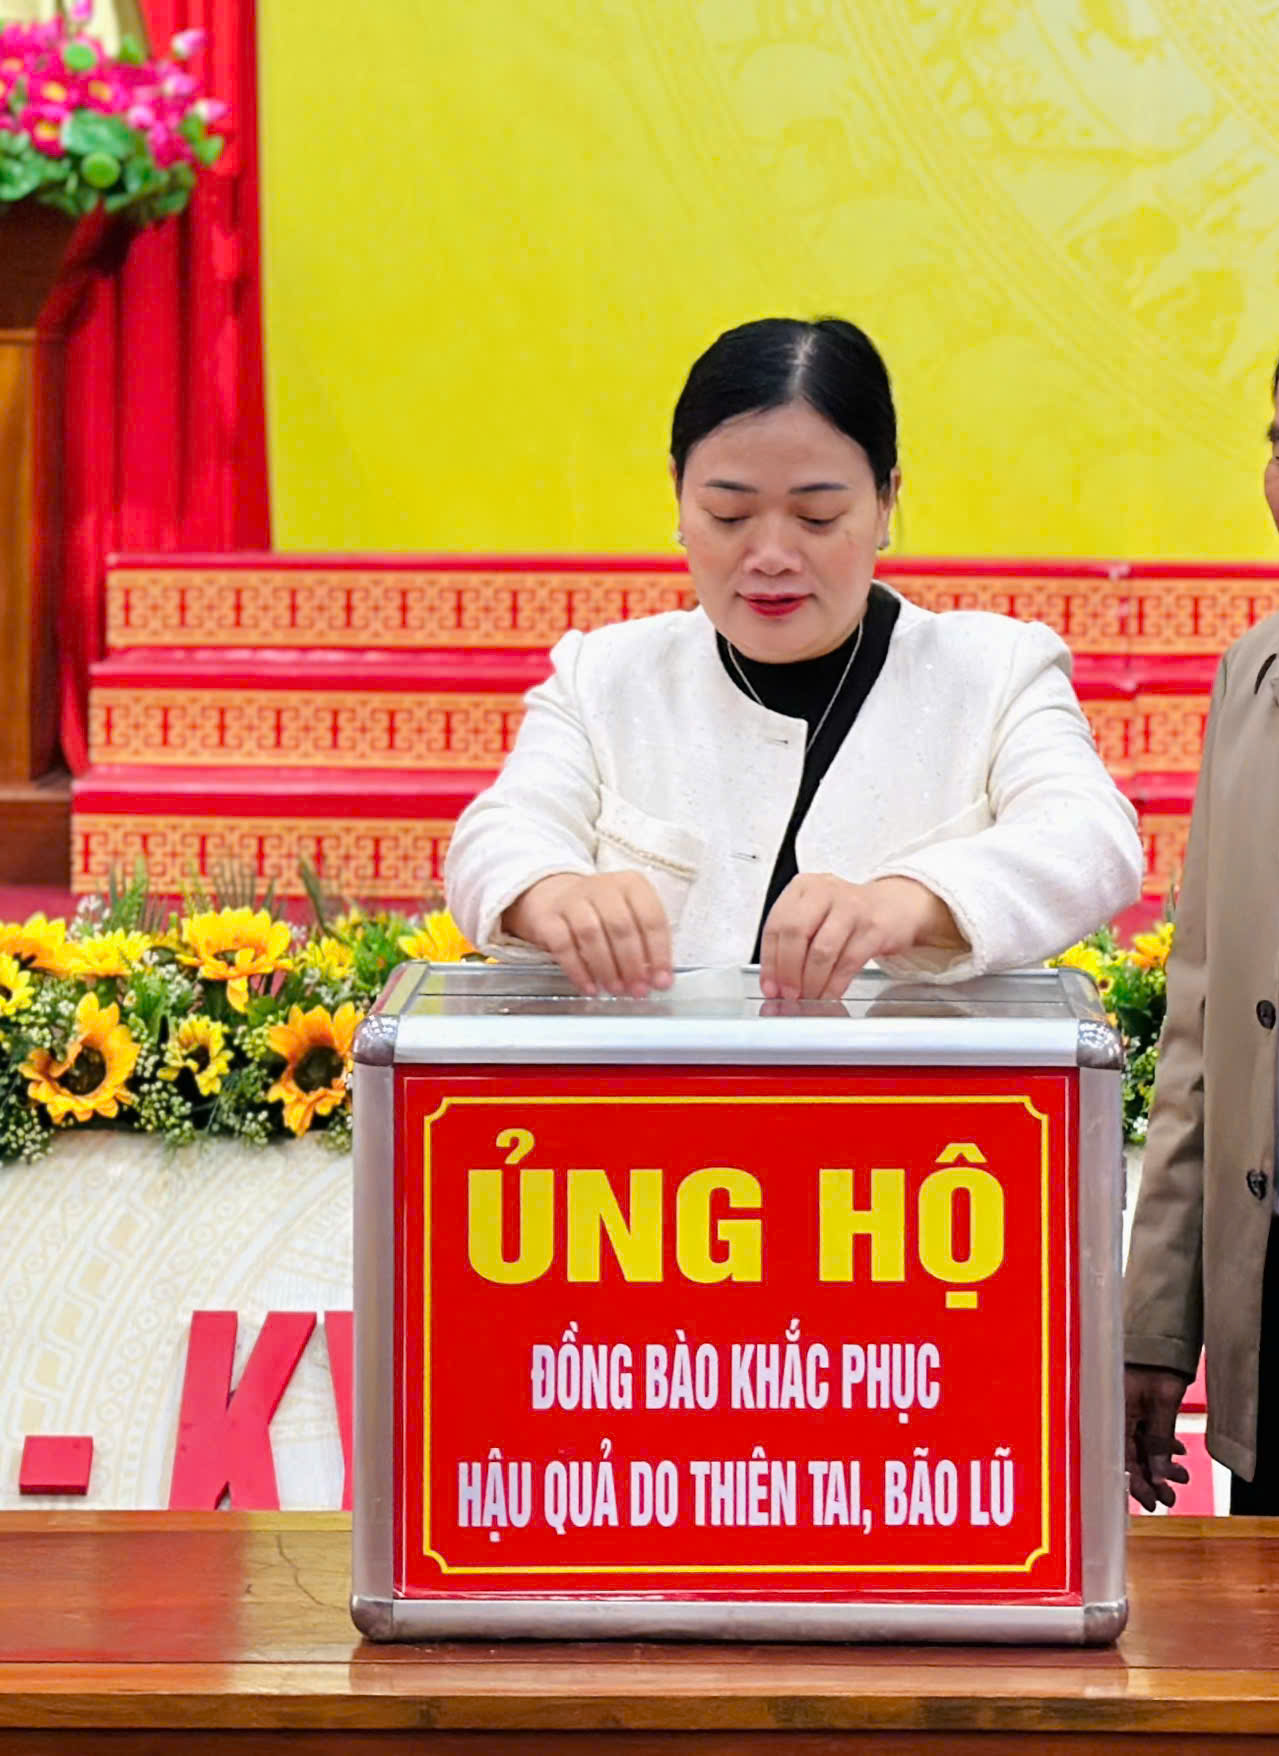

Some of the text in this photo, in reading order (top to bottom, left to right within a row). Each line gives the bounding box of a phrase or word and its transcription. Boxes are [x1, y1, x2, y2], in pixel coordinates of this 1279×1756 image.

[468, 1129, 1004, 1309] ỦNG HỘ
[531, 1319, 940, 1424] ĐỒNG BÀO KHẮC PHỤC
[459, 1438, 1013, 1542] HẬU QUẢ DO THIÊN TAI, BÃO LŨ
